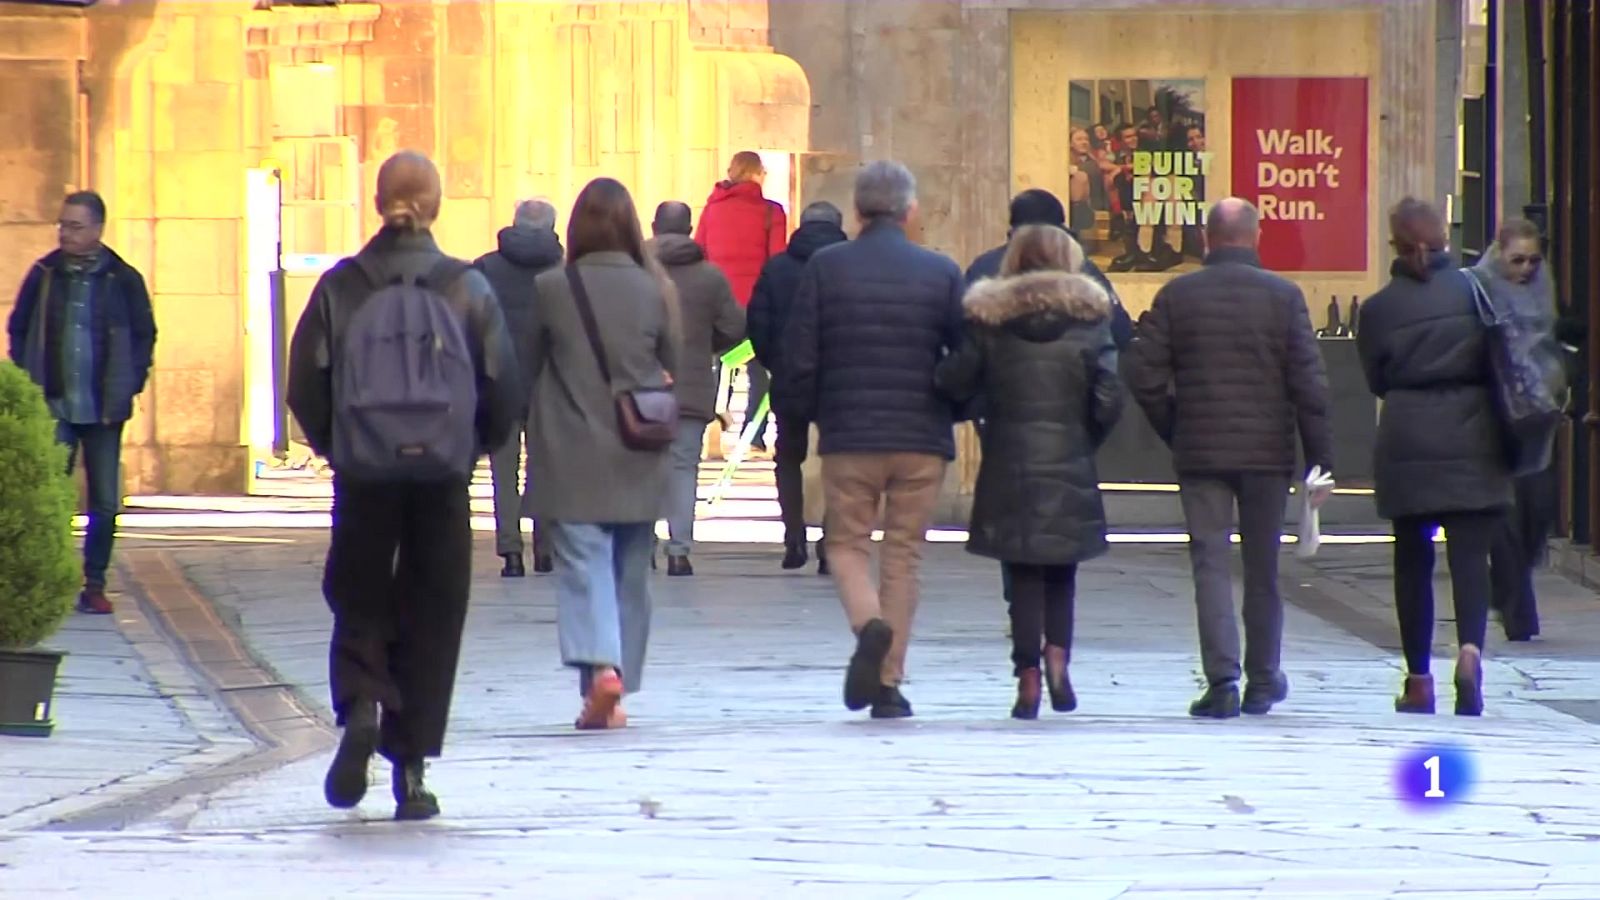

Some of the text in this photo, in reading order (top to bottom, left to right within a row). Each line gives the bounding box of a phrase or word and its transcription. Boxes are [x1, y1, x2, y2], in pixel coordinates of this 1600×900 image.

[1256, 128, 1343, 159] Walk,
[1133, 151, 1215, 176] BUILT
[1257, 161, 1339, 188] Don't
[1133, 176, 1193, 200] FOR
[1257, 194, 1325, 220] Run.
